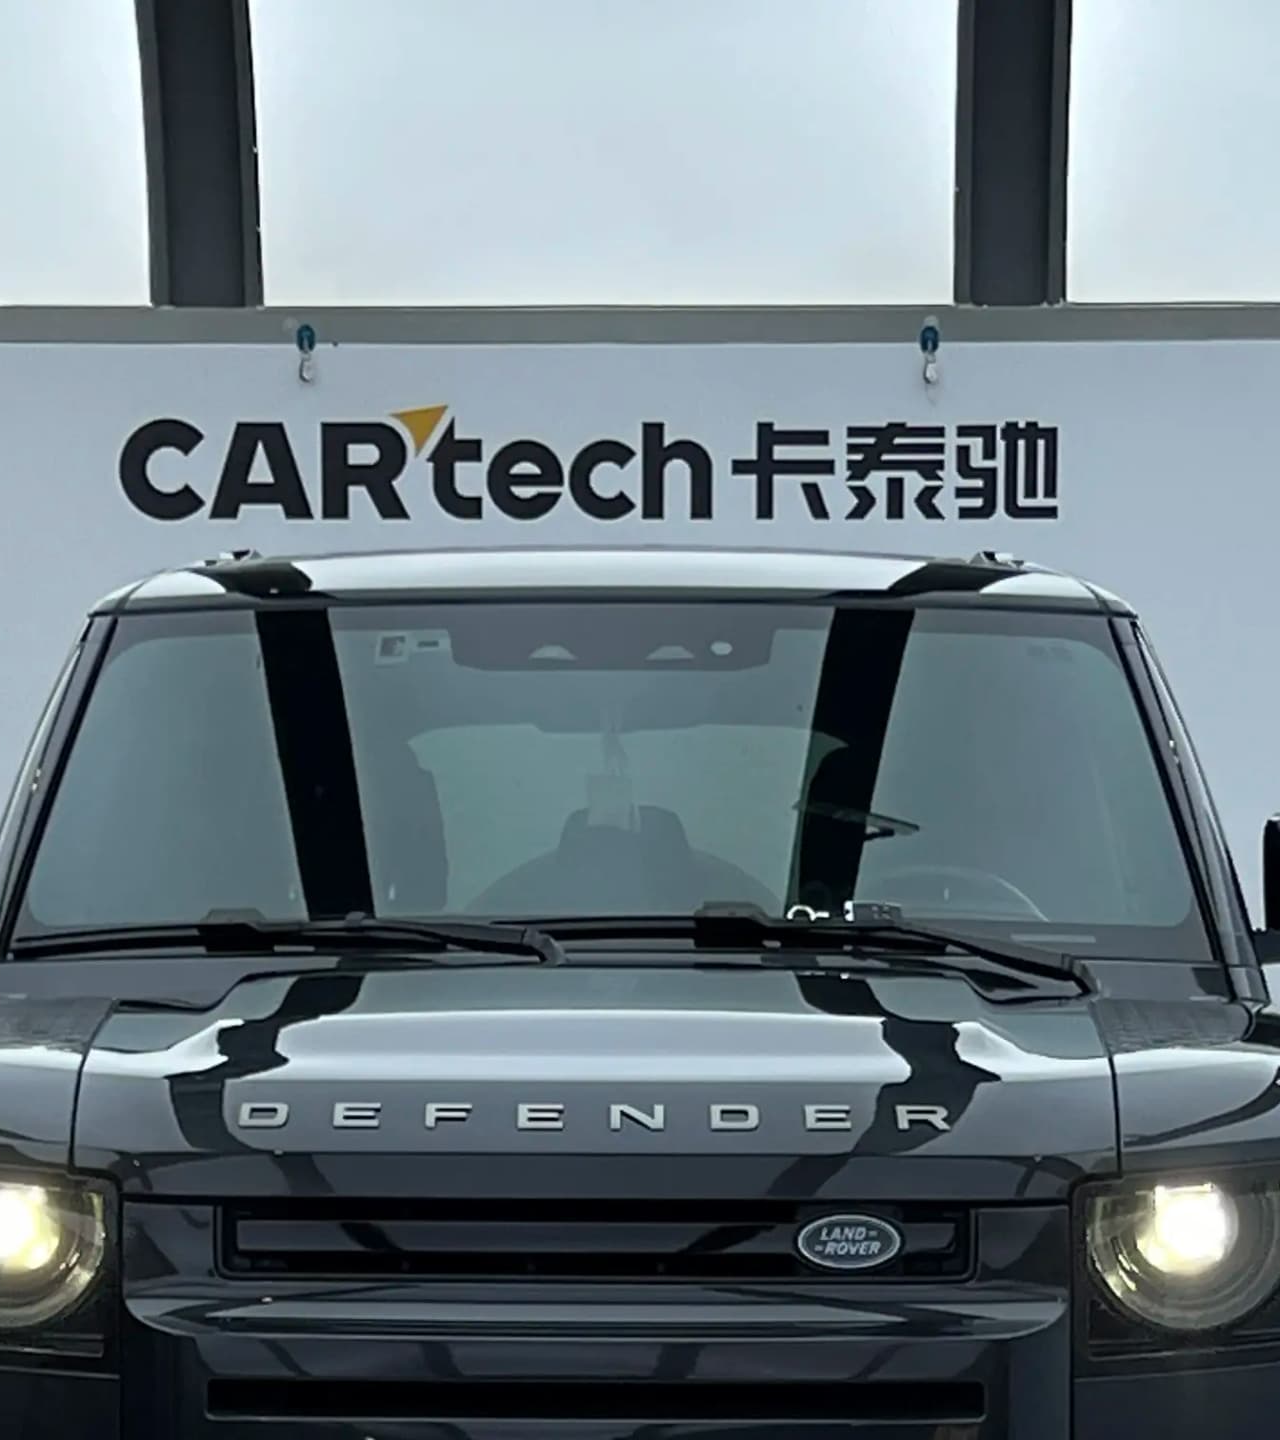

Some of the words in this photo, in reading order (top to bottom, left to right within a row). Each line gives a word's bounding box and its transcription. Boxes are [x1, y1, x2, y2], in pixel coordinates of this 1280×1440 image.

[119, 417, 713, 521] CARtech
[730, 420, 1059, 521] 卡泰驰
[237, 1102, 952, 1131] DEFENDER
